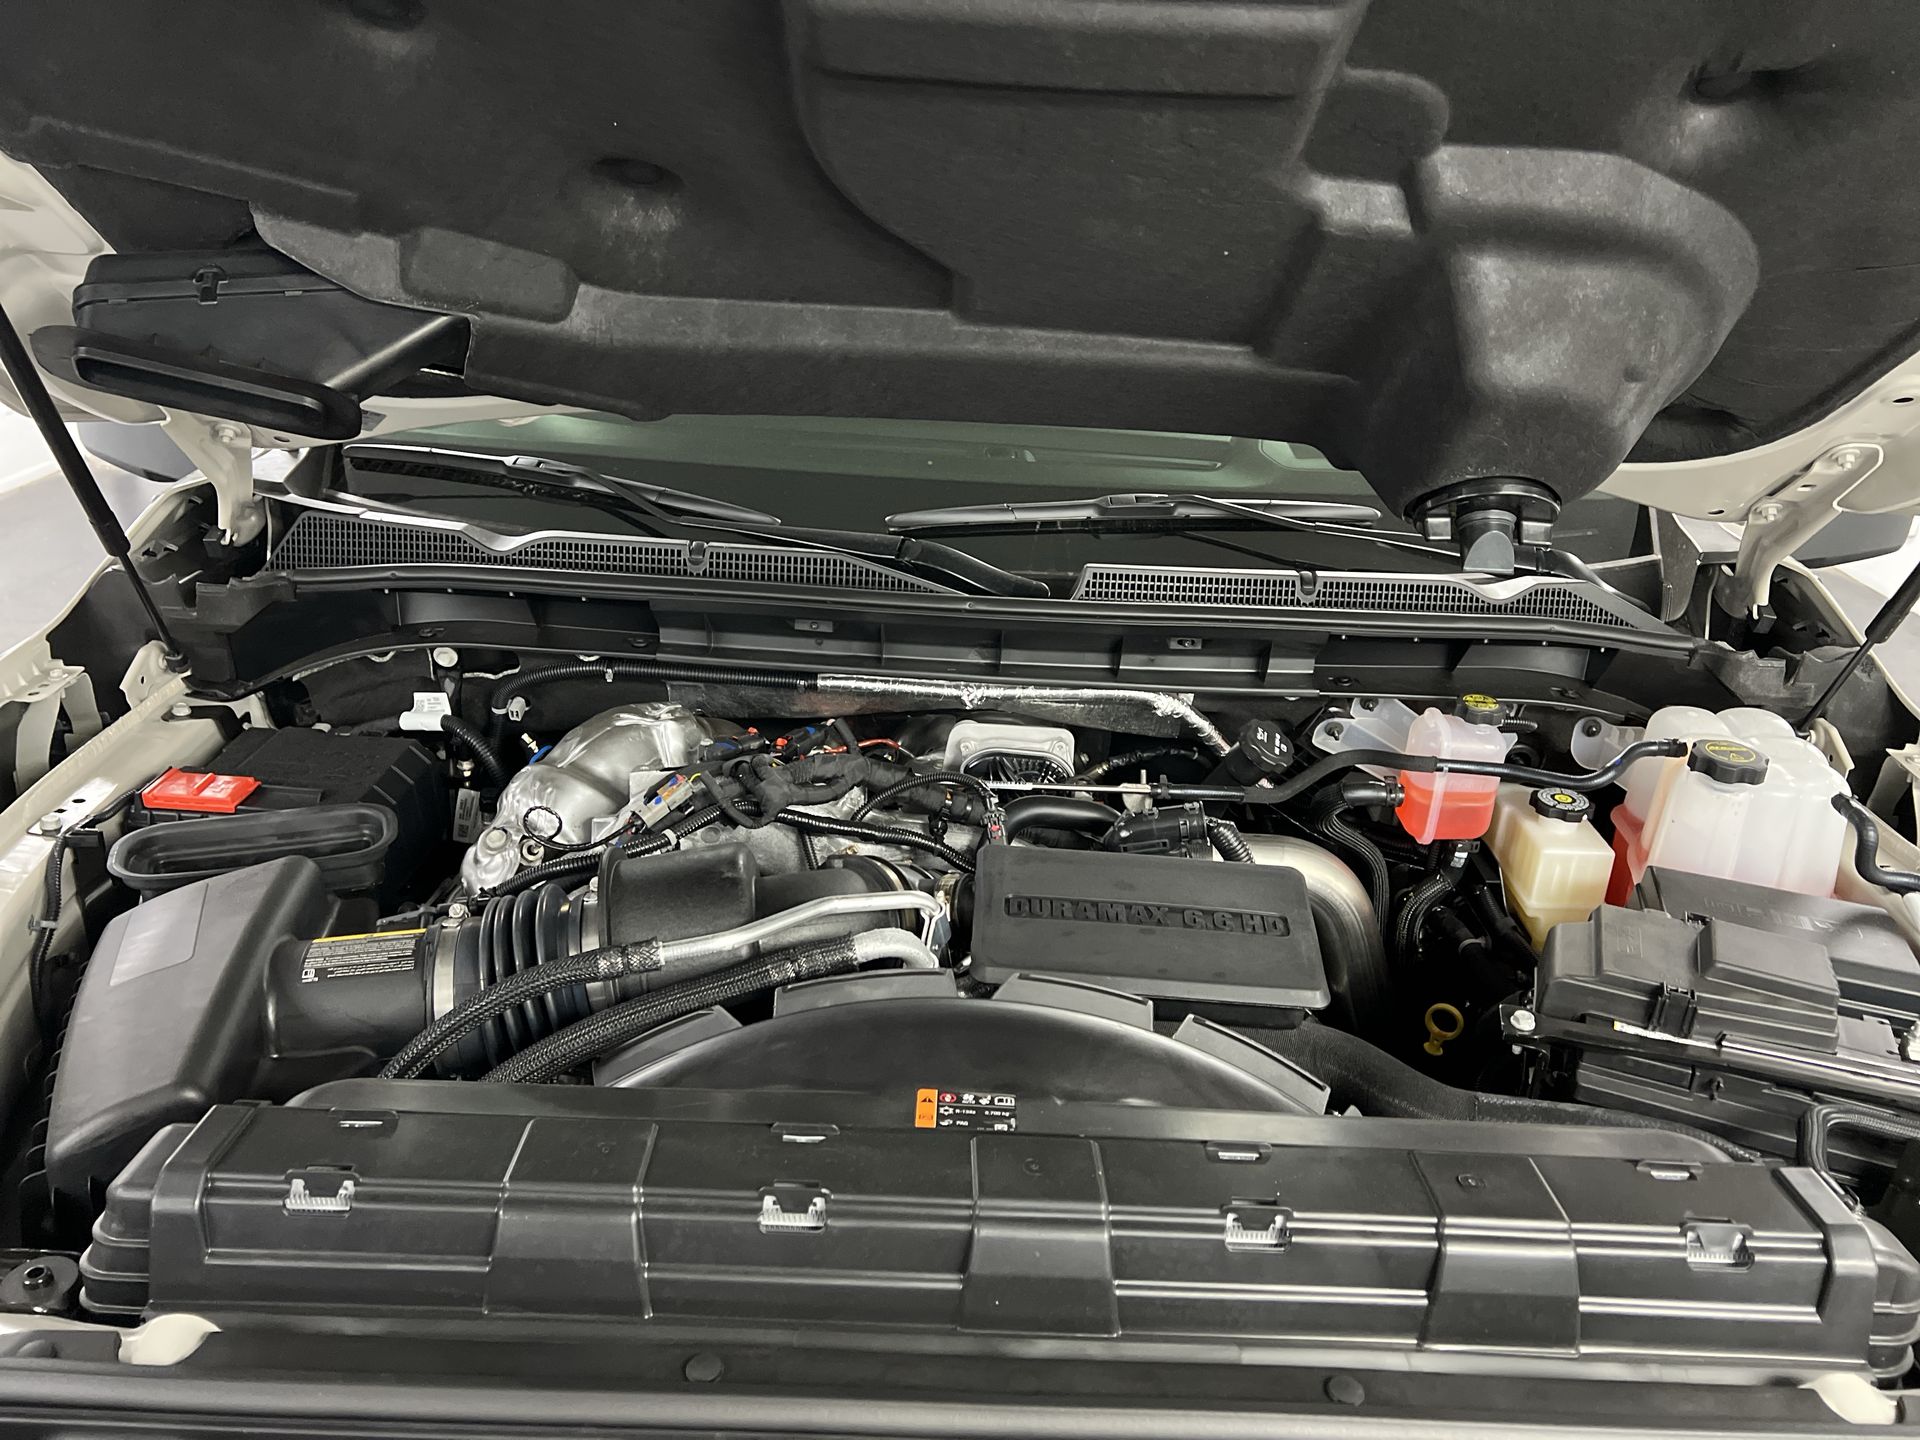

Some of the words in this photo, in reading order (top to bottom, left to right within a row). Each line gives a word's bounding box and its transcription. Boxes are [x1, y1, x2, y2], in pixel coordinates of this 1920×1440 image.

[1008, 897, 1170, 926] DURAMAX
[1182, 910, 1234, 931] 6.6
[1240, 913, 1289, 936] HD
